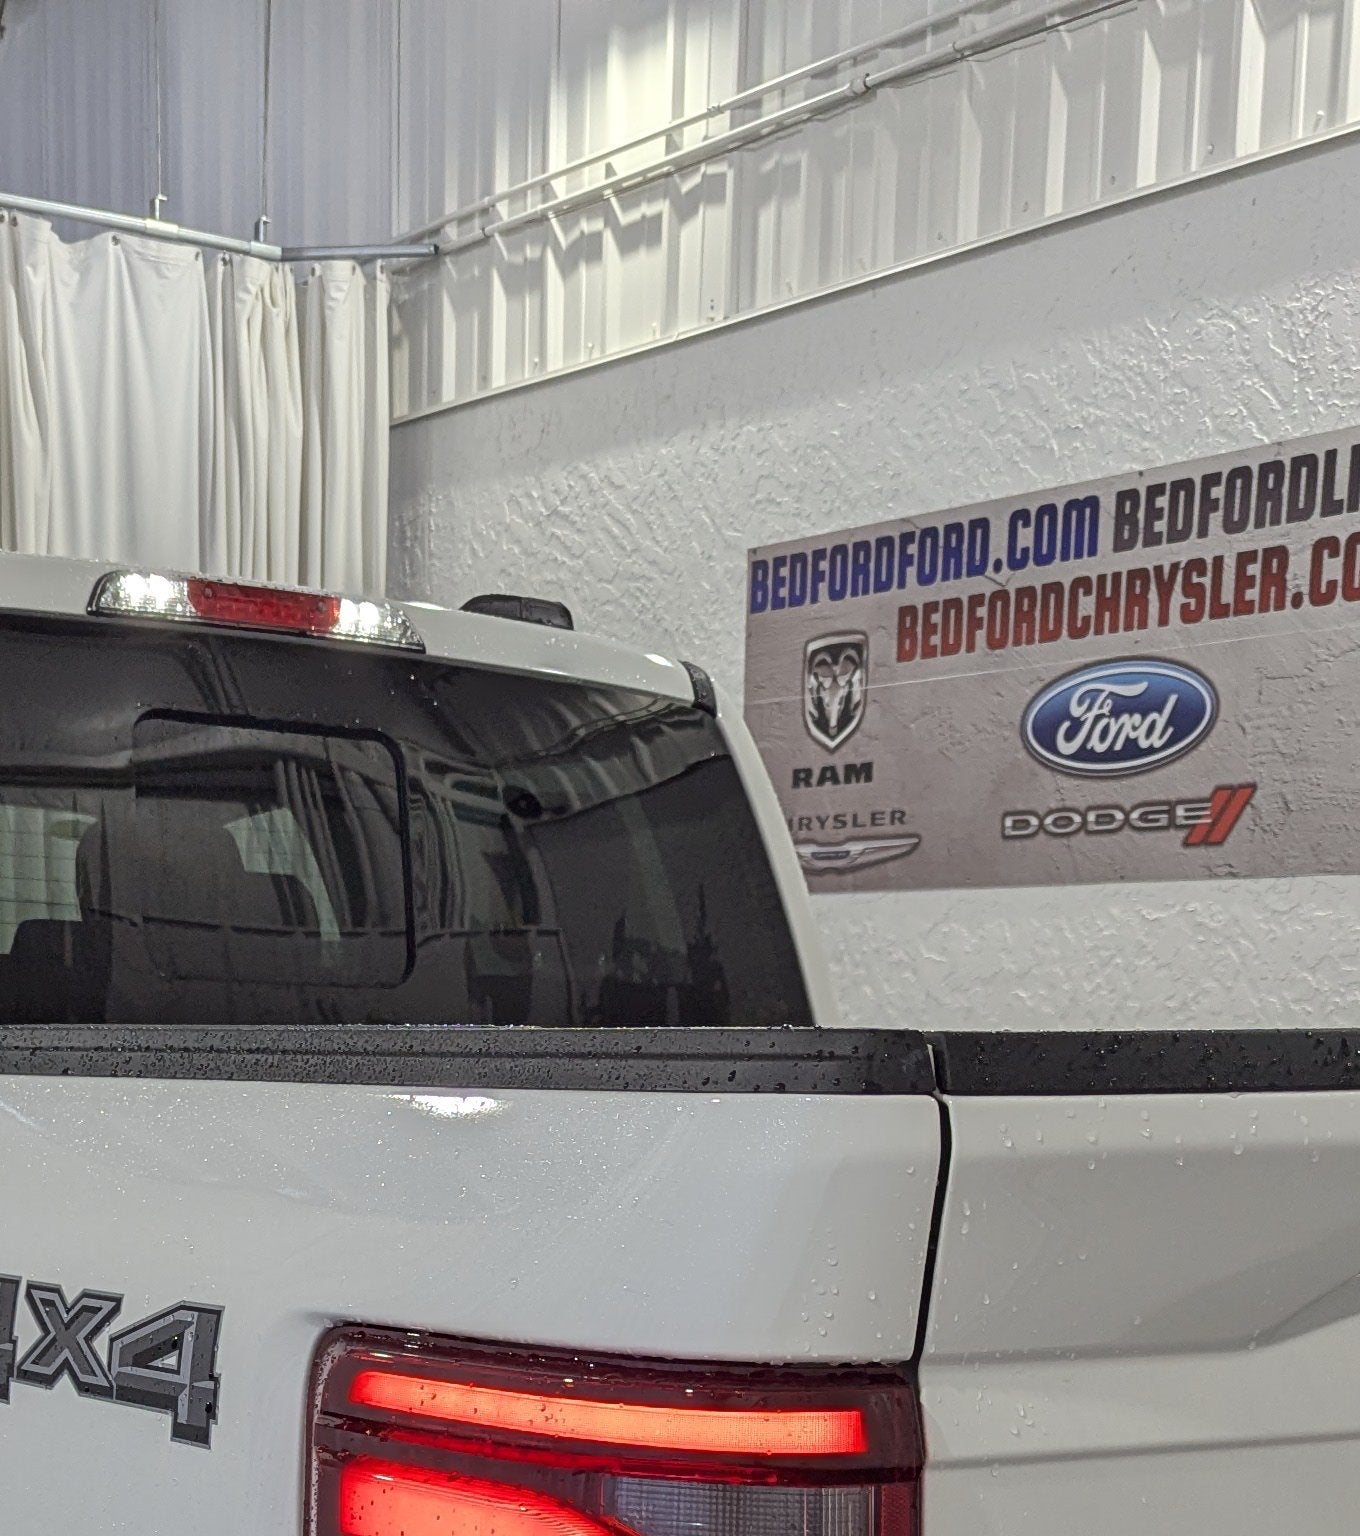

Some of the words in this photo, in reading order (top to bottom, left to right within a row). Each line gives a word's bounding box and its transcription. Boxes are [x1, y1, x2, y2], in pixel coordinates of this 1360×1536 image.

[750, 495, 1100, 614] BEDFORDFORD.COM
[1056, 682, 1178, 755] Ford
[791, 762, 874, 789] RAM
[787, 809, 907, 832] RYSLER
[1001, 798, 1213, 839] DODGE
